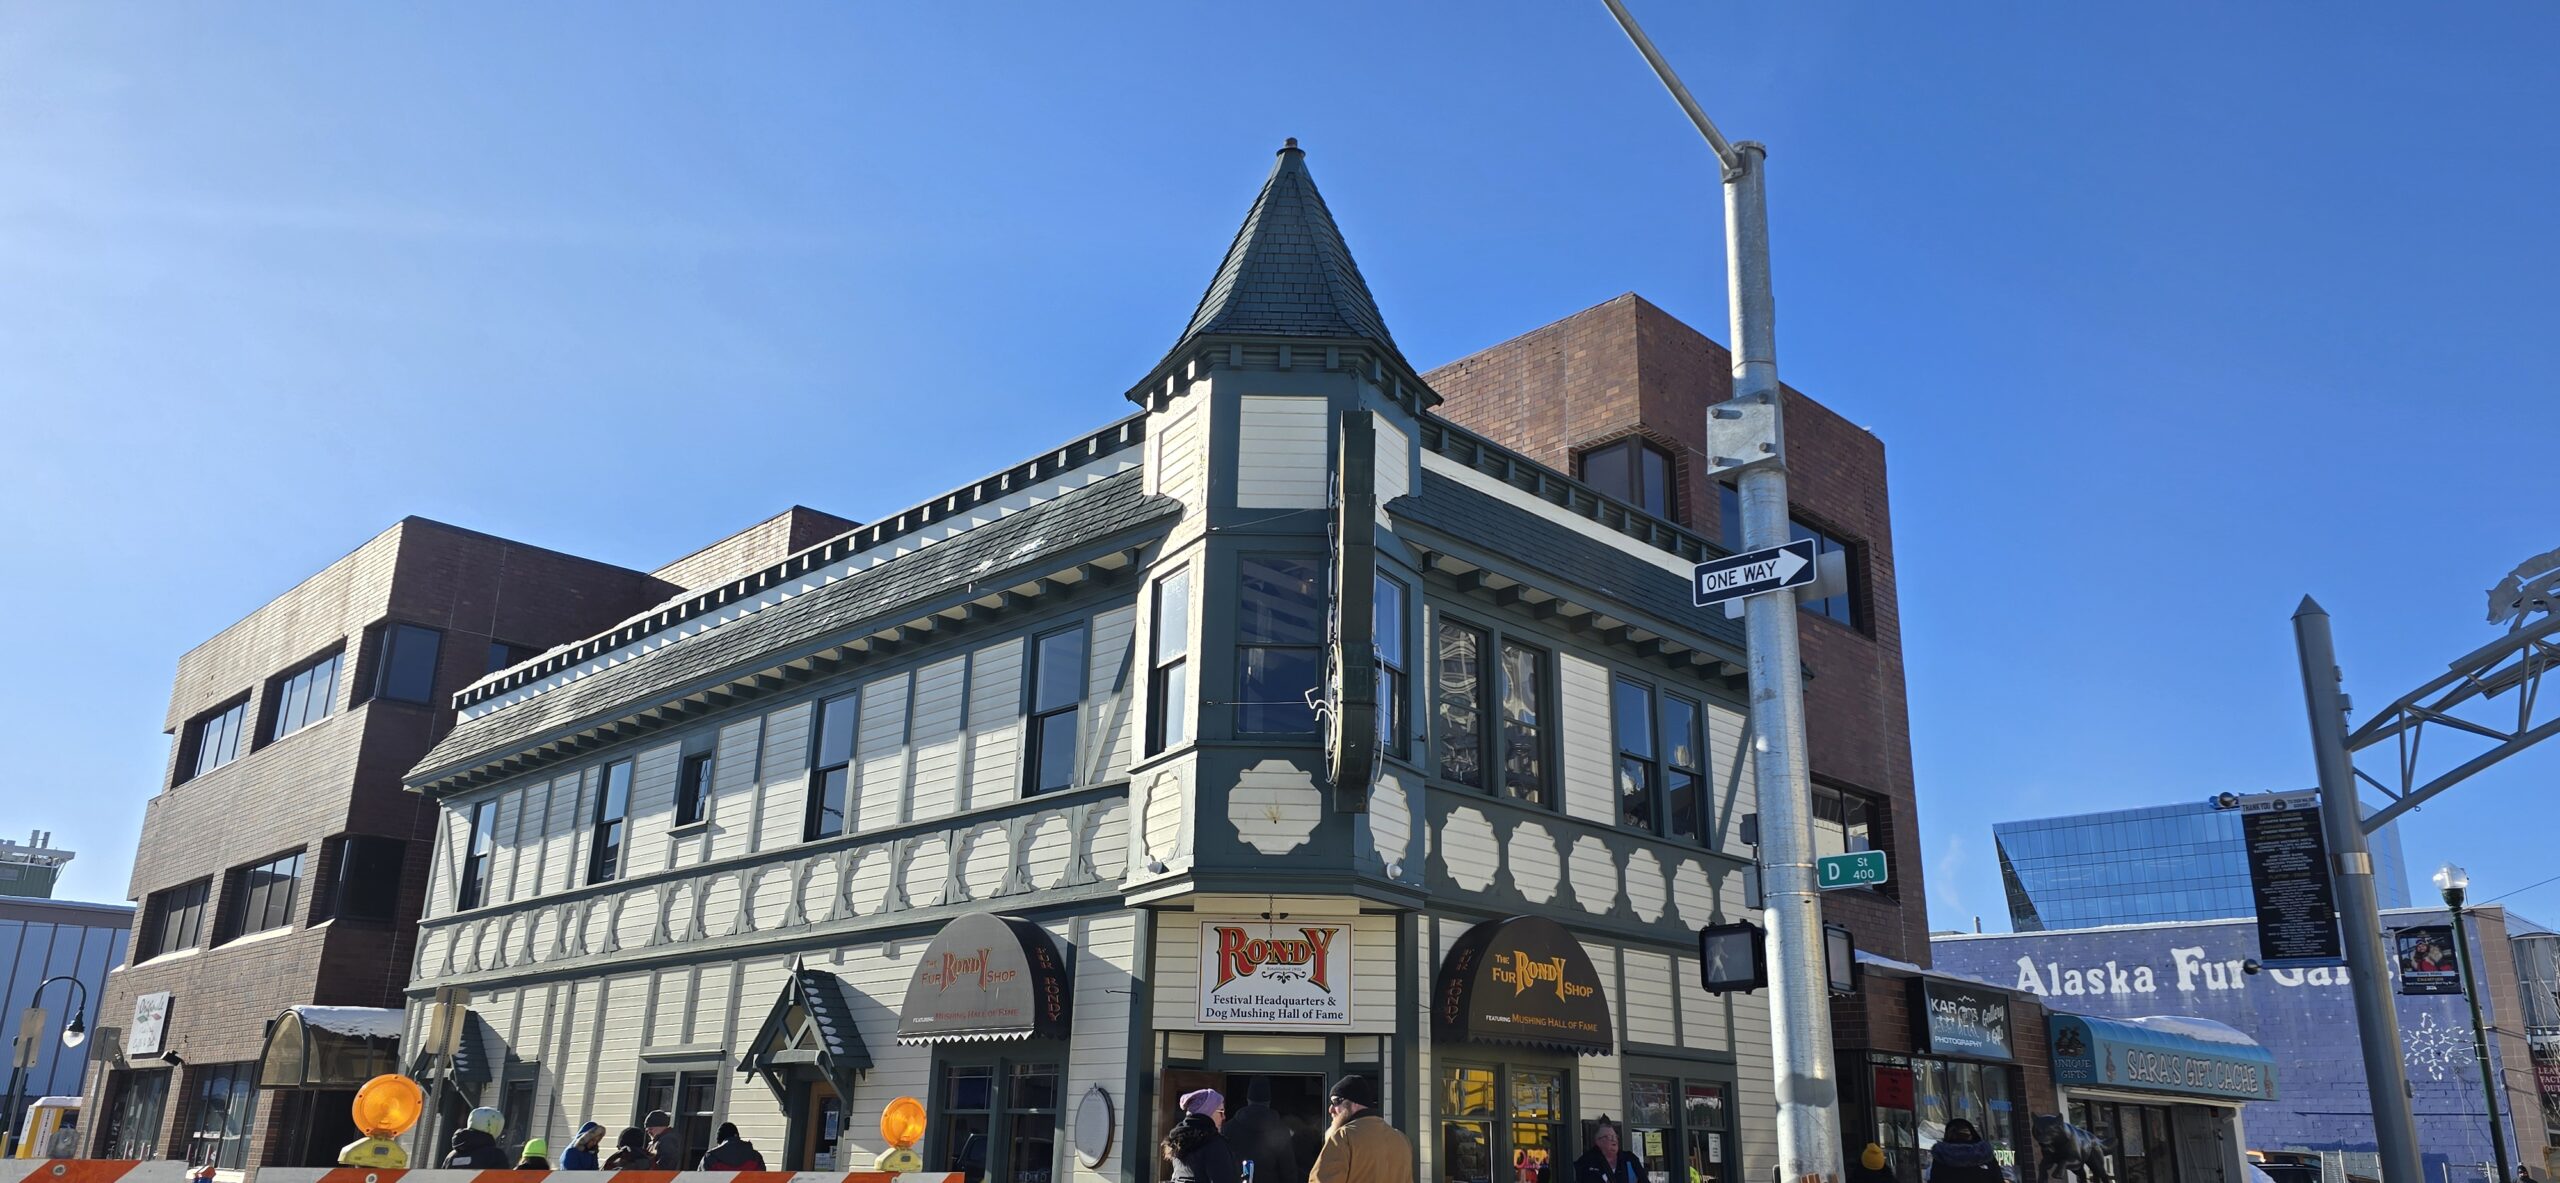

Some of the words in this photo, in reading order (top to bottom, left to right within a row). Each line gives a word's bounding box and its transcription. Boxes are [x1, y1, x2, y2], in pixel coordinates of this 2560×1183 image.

[1706, 570, 1738, 592] ONE
[1743, 560, 1777, 584] WAY
[2243, 802, 2260, 812] THANK
[2260, 802, 2271, 810] YOU
[1827, 862, 1840, 881] D
[1857, 857, 1869, 868] St
[1853, 868, 1875, 881] 400
[2016, 955, 2158, 997] Alaska
[2171, 946, 2246, 991] Fur
[1044, 976, 1062, 1022] RONDY
[1213, 994, 1252, 1006] Festival
[1255, 995, 1325, 1009] Headquarters
[1327, 996, 1337, 1007] &
[1206, 1007, 1228, 1021] Dog
[1230, 1007, 1276, 1022] Mushing
[1278, 1007, 1300, 1020] Hall
[1302, 1008, 1314, 1020] of
[1315, 1009, 1344, 1020] Fame
[1485, 1014, 1511, 1024] FEATURING
[1512, 1013, 1546, 1027] MUSHING
[1547, 1017, 1567, 1029] HALL
[1578, 1021, 1598, 1032] FAME
[1982, 1004, 2005, 1027] Gallery
[1934, 1035, 1983, 1048] PHOTOGRAPHY
[2054, 1058, 2092, 1069] UNIQUE
[2127, 1050, 2182, 1086] SARA'S
[2184, 1057, 2213, 1089] GIFT
[2215, 1061, 2259, 1093] CACHE
[2061, 1069, 2088, 1080] GIFTS
